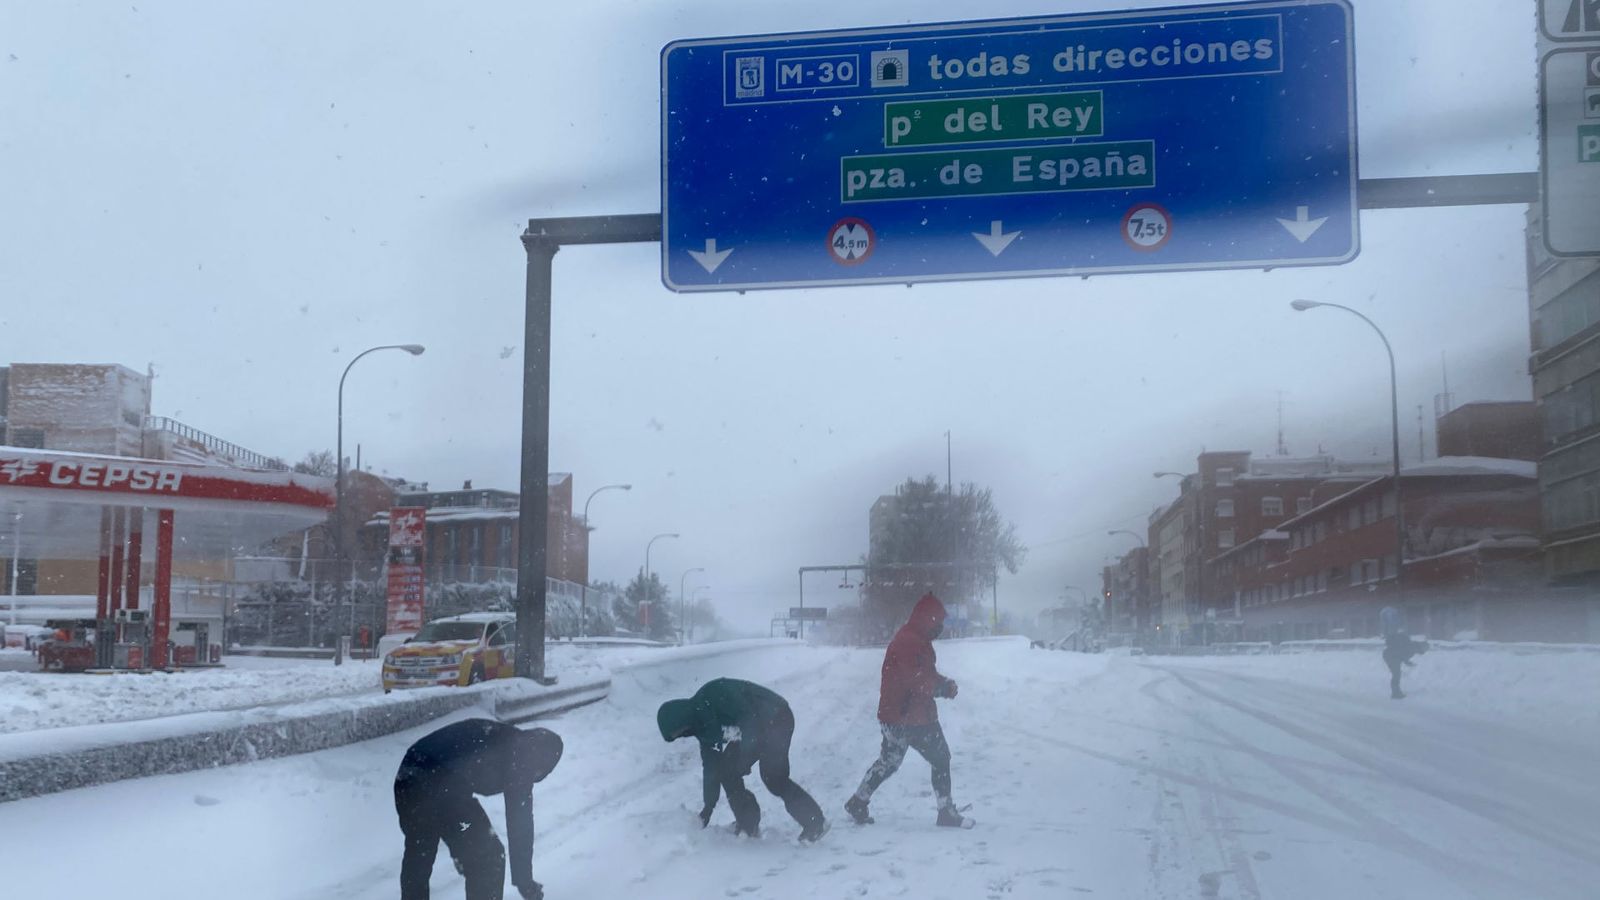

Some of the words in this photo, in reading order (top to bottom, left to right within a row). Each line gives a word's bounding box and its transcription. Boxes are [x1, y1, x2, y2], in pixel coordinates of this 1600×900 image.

[781, 61, 854, 85] M-30
[928, 51, 1030, 80] todas
[1053, 38, 1273, 73] direcciones
[944, 104, 1003, 133] del
[1027, 103, 1094, 132] Rey
[847, 166, 916, 197] pza.
[939, 159, 983, 185] de
[1012, 151, 1148, 186] España
[1130, 218, 1164, 238] 7,5t
[48, 460, 183, 491] CEPSA
